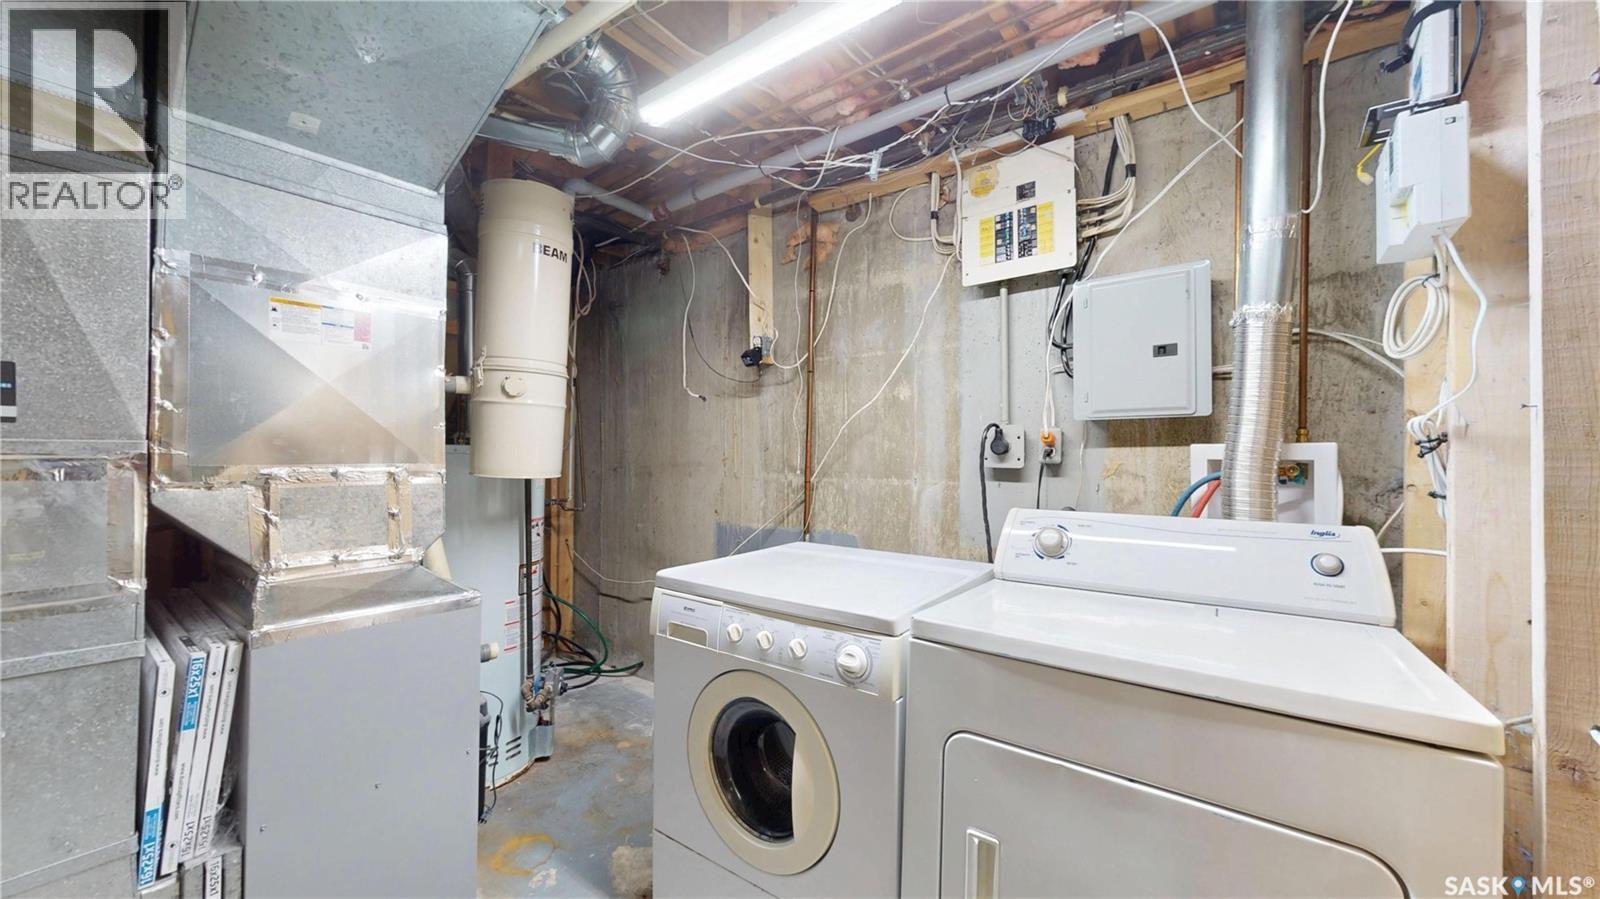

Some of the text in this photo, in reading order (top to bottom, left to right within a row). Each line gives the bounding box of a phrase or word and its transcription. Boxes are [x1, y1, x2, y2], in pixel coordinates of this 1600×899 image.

[532, 242, 568, 263] BEAM
[187, 657, 204, 698] 16x25x1
[140, 841, 155, 887] 16x25x1
